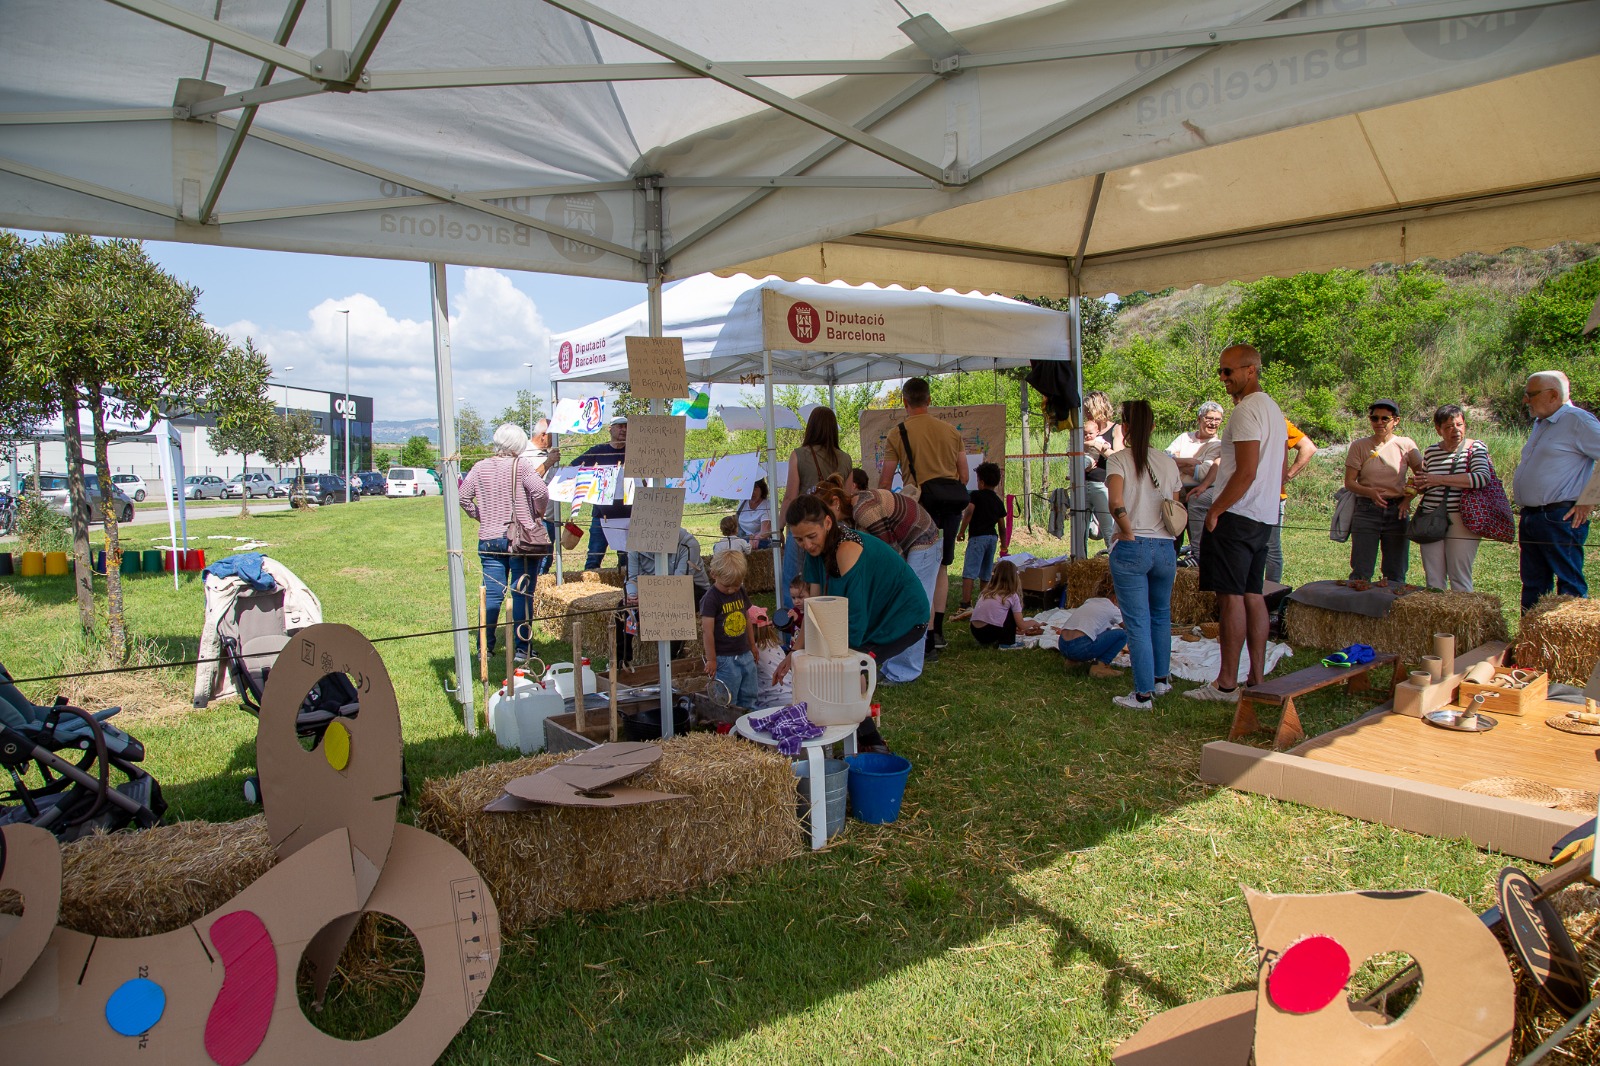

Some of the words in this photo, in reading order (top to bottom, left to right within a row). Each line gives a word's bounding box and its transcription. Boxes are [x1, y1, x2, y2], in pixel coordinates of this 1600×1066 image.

[825, 310, 885, 326] Diputació
[826, 327, 886, 342] Barcelona
[575, 337, 606, 355] Diputació
[575, 353, 606, 368] Barcelona
[636, 489, 678, 505] CONFIEM
[647, 577, 683, 587] DECIDIM
